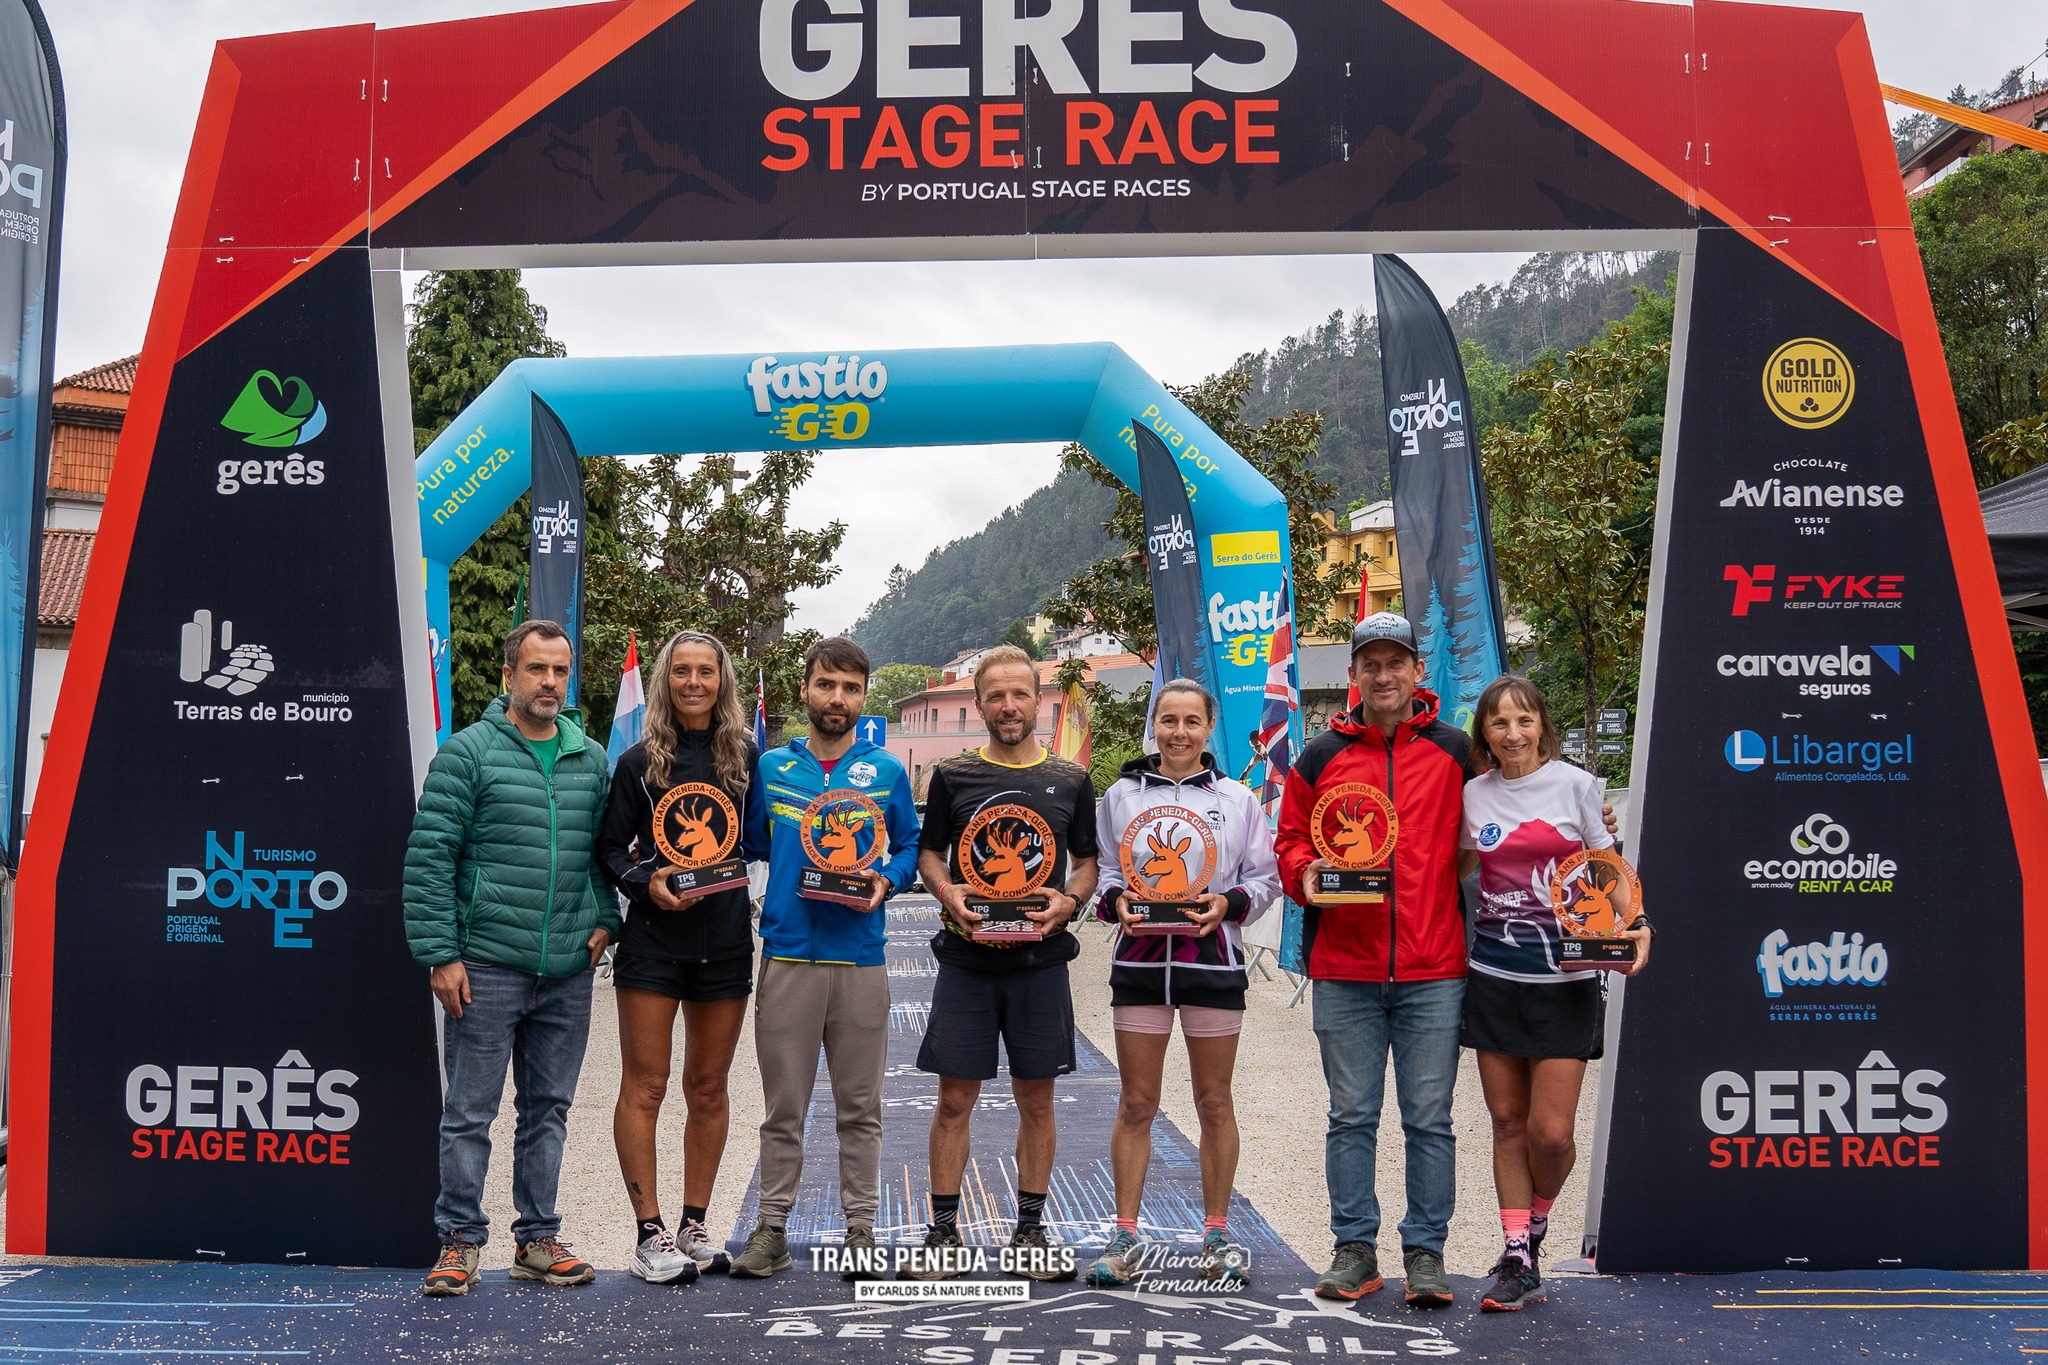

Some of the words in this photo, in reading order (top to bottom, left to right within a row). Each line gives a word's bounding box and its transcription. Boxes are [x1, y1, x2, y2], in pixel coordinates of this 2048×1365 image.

[761, 103, 1025, 171] STAGE
[1065, 99, 1280, 166] RACE
[861, 184, 892, 201] BY
[897, 182, 1026, 200] PORTUGAL
[1031, 180, 1106, 198] STAGE
[1113, 179, 1191, 197] RACES
[1780, 358, 1836, 378] GOLD
[744, 355, 888, 417] fastio
[1776, 379, 1842, 393] NUTRITION
[771, 402, 870, 441] GO
[1141, 403, 1184, 447] Pura
[1180, 444, 1220, 475] por
[217, 452, 325, 495] gerês
[416, 459, 457, 501] Pura
[455, 425, 488, 465] por
[1773, 458, 1848, 472] CHOCOLATE
[432, 447, 515, 525] natureza.
[1800, 526, 1825, 535] 1914
[1217, 555, 1239, 563] Serra
[1242, 553, 1253, 561] do
[1255, 552, 1278, 561] Gerês
[1785, 575, 1904, 599] FYKE
[1784, 601, 1816, 609] KEEP
[1817, 601, 1842, 609] OUT
[1843, 601, 1860, 609] OF
[1861, 601, 1902, 609] TRACK
[1208, 591, 1280, 643] fasti
[1717, 645, 1871, 677] caravela
[303, 693, 349, 704] município
[1224, 685, 1241, 694] Água
[1243, 684, 1265, 692] Minera
[1799, 683, 1871, 699] seguros
[174, 701, 243, 720] Terras
[250, 702, 277, 721] de
[284, 702, 353, 722] Bouro
[1772, 734, 1912, 771] Libargel
[1775, 772, 1823, 782] Alimentos
[1825, 772, 1886, 783] Congelados,
[1888, 772, 1909, 781] Lda.
[655, 797, 671, 829] TRANS
[1313, 793, 1334, 821] TRANS
[961, 815, 986, 847] TRANS
[253, 849, 317, 862] TURISMO
[663, 845, 682, 864] RACE
[682, 858, 699, 866] FOR
[700, 825, 737, 866] CONQUERORS
[803, 839, 818, 859] RACE
[817, 857, 832, 870] FOR
[834, 844, 880, 872] CONQUERORS
[1317, 840, 1334, 862] RACE
[1333, 858, 1349, 869] FOR
[1351, 834, 1395, 869] CONQUERORS
[677, 873, 695, 883] TPG
[805, 872, 821, 881] TPG
[1322, 874, 1340, 882] TPG
[1744, 854, 1897, 880] ecomobile
[964, 869, 983, 891] RACE
[983, 887, 1000, 897] FOR
[1002, 860, 1051, 898] CONQUERORS
[1770, 881, 1794, 890] mobility
[1799, 881, 1841, 893] RENT
[1842, 881, 1856, 893] A
[1858, 880, 1893, 892] CAR
[167, 915, 221, 925] PORTUGAL
[972, 905, 989, 913] TPG
[1133, 905, 1149, 914] TPG
[166, 924, 207, 934] ORIGEM
[166, 933, 173, 942] E
[174, 933, 224, 943] ORIGINAL
[1563, 943, 1582, 951] TPG
[1756, 929, 1888, 997] fastio
[1770, 1003, 1791, 1011] ÁGUA
[1770, 1013, 1810, 1021] SERRA
[1815, 1013, 1833, 1021] DO
[1838, 1010, 1877, 1020] GERÊS
[125, 1049, 360, 1132] GERÊS
[1700, 1050, 1948, 1134] GERÊS
[131, 1129, 246, 1161] STAGE
[257, 1132, 350, 1165] RACE
[1709, 1136, 1830, 1168] STAGE
[1841, 1135, 1940, 1167] RACE
[765, 1321, 1024, 1342] BEST
[1075, 1327, 1460, 1357] TRAILS
